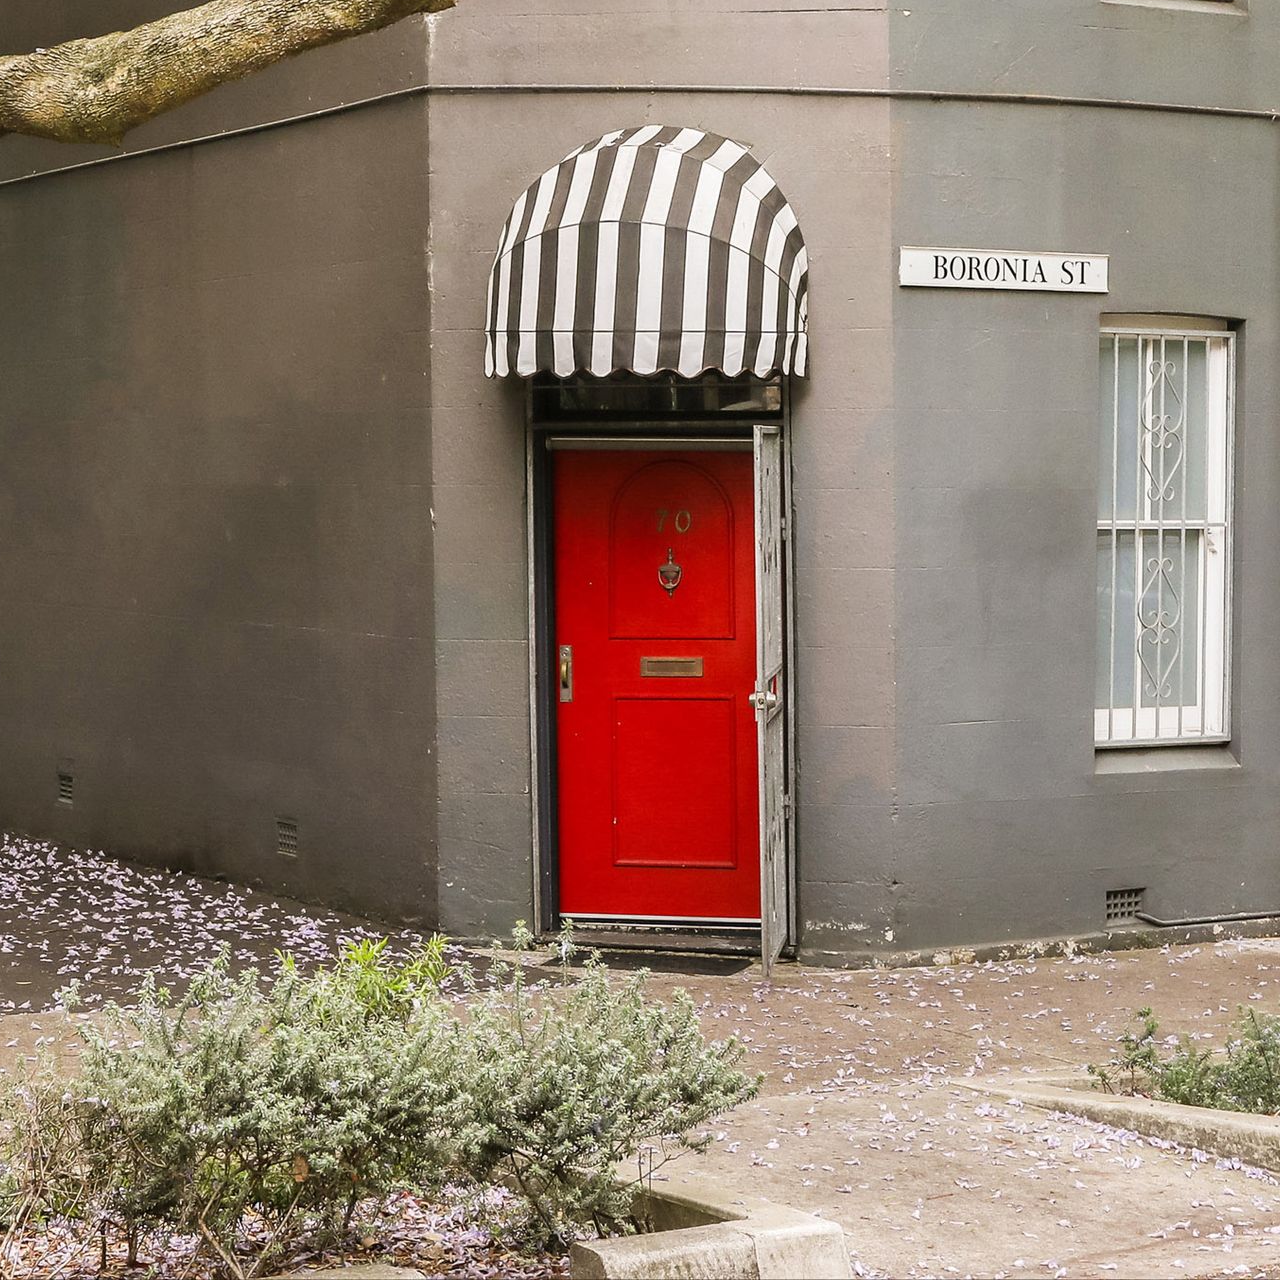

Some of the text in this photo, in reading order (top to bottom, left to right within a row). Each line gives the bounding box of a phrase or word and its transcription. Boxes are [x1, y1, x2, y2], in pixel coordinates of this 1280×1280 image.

[933, 255, 1091, 285] BORONIA ST
[656, 510, 692, 534] 70
